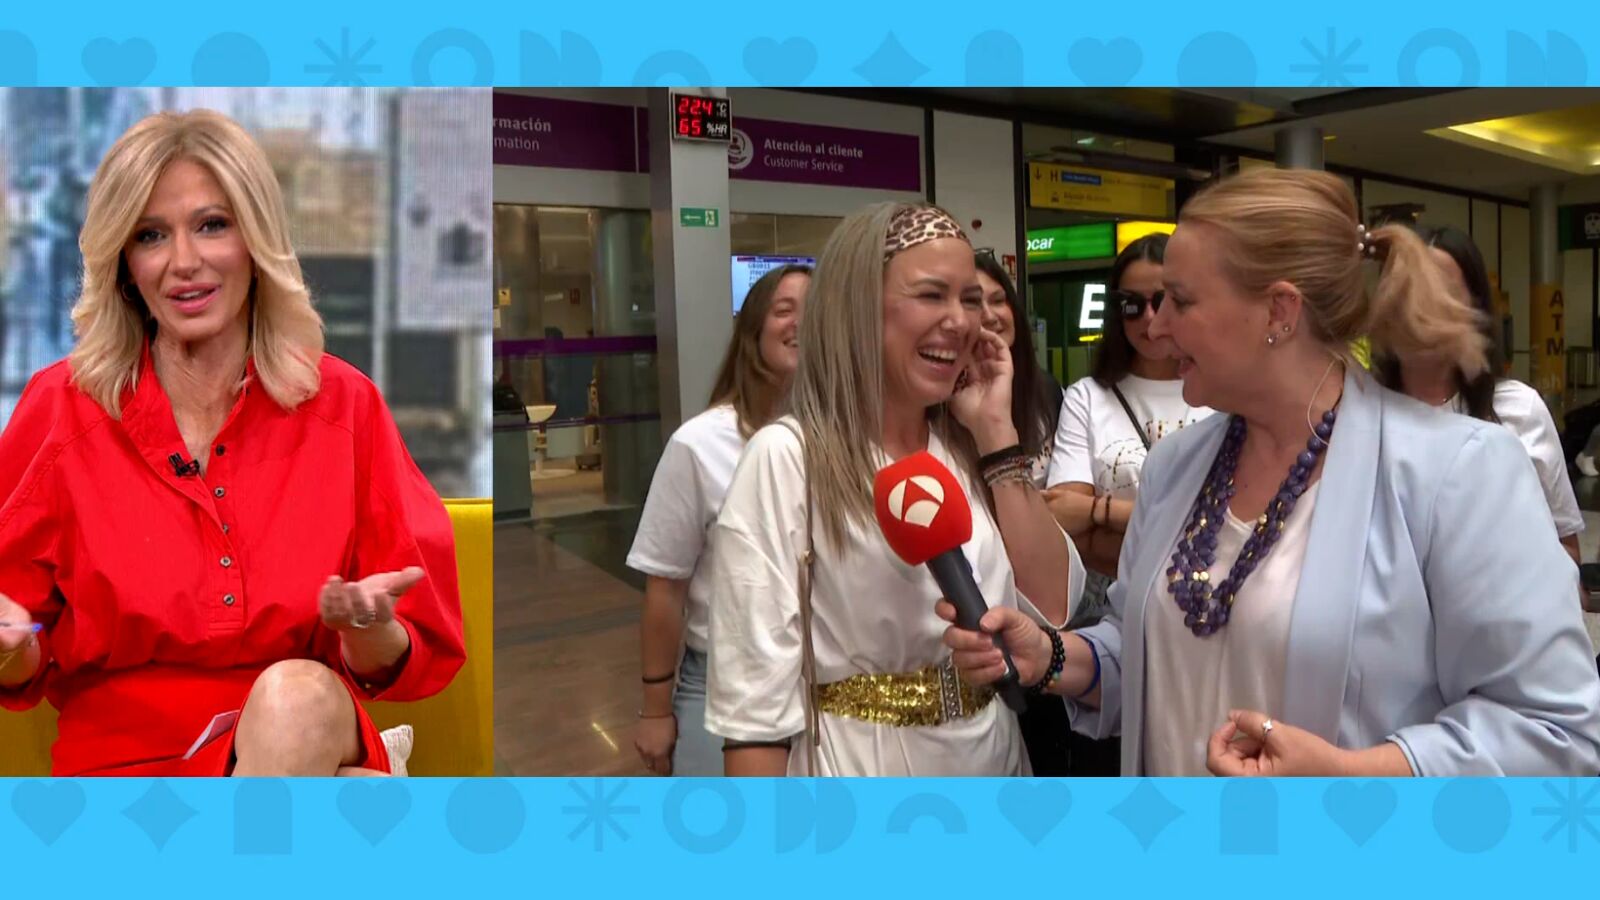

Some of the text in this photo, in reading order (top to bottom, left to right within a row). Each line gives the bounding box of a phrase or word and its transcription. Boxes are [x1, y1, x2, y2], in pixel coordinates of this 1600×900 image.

[493, 116, 552, 132] rmación
[679, 118, 702, 136] 65
[494, 136, 540, 151] mation
[764, 138, 864, 159] Atención al cliente
[763, 154, 844, 173] Customer Service
[1546, 288, 1565, 356] ATM
